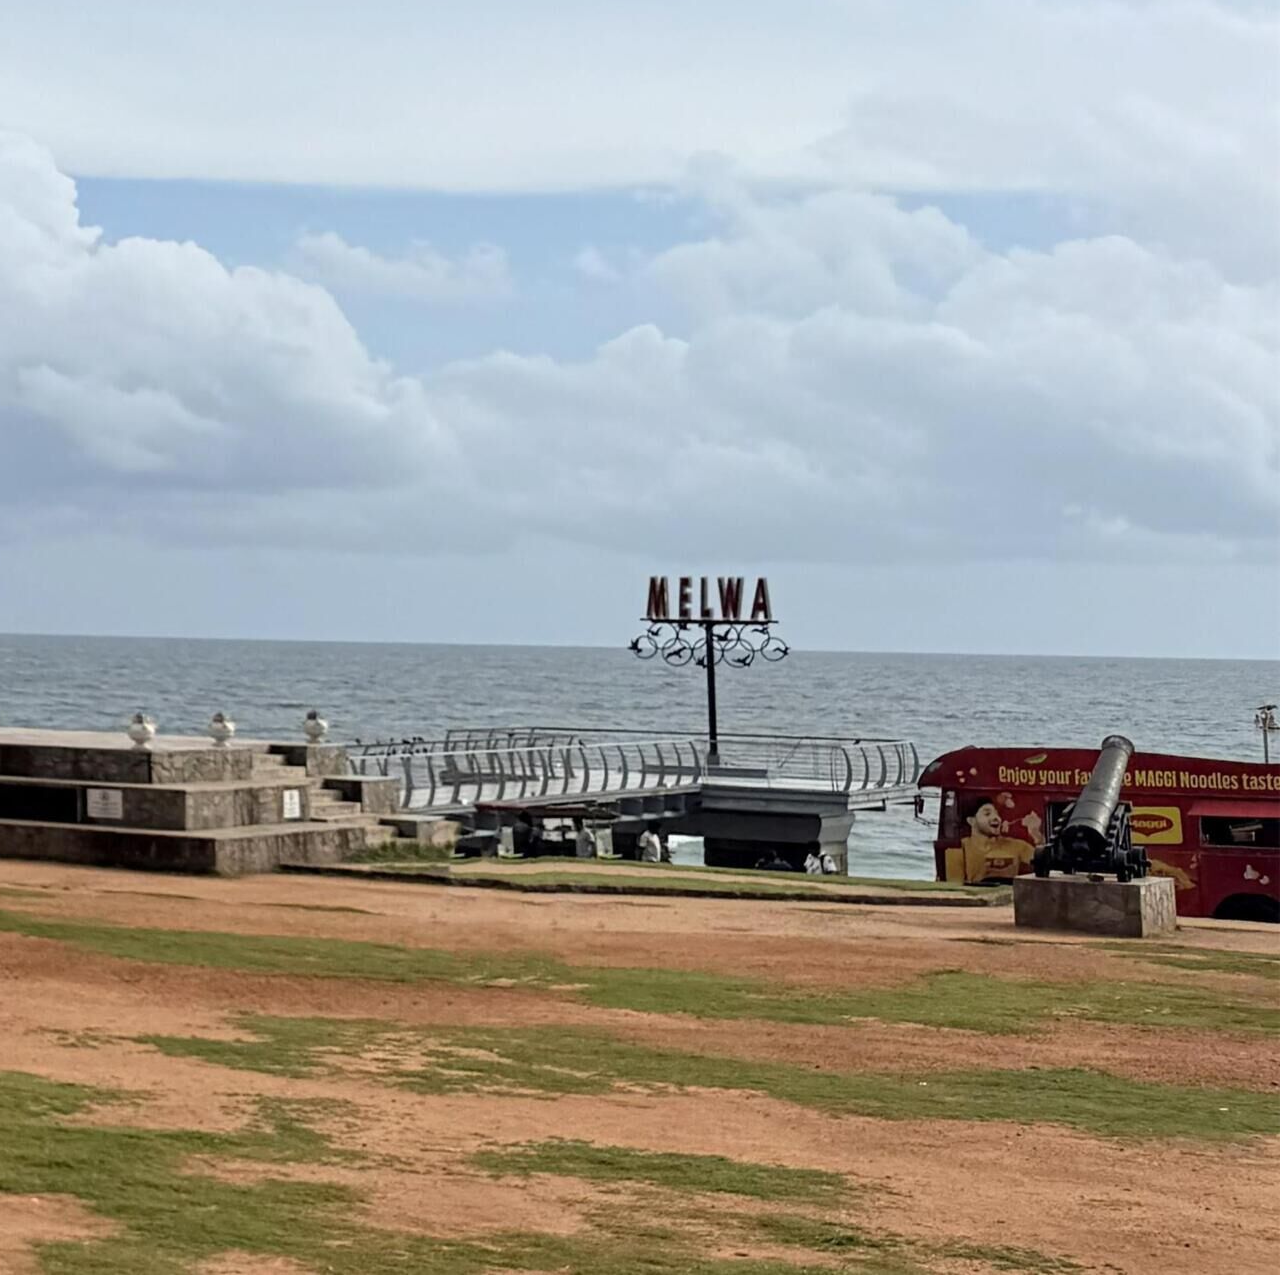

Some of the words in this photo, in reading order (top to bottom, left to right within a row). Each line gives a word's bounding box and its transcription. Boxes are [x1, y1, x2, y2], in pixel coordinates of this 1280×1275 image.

[646, 576, 772, 619] MELWA
[1039, 769, 1071, 785] your
[1180, 771, 1239, 790] Noodles
[1242, 773, 1280, 790] taste
